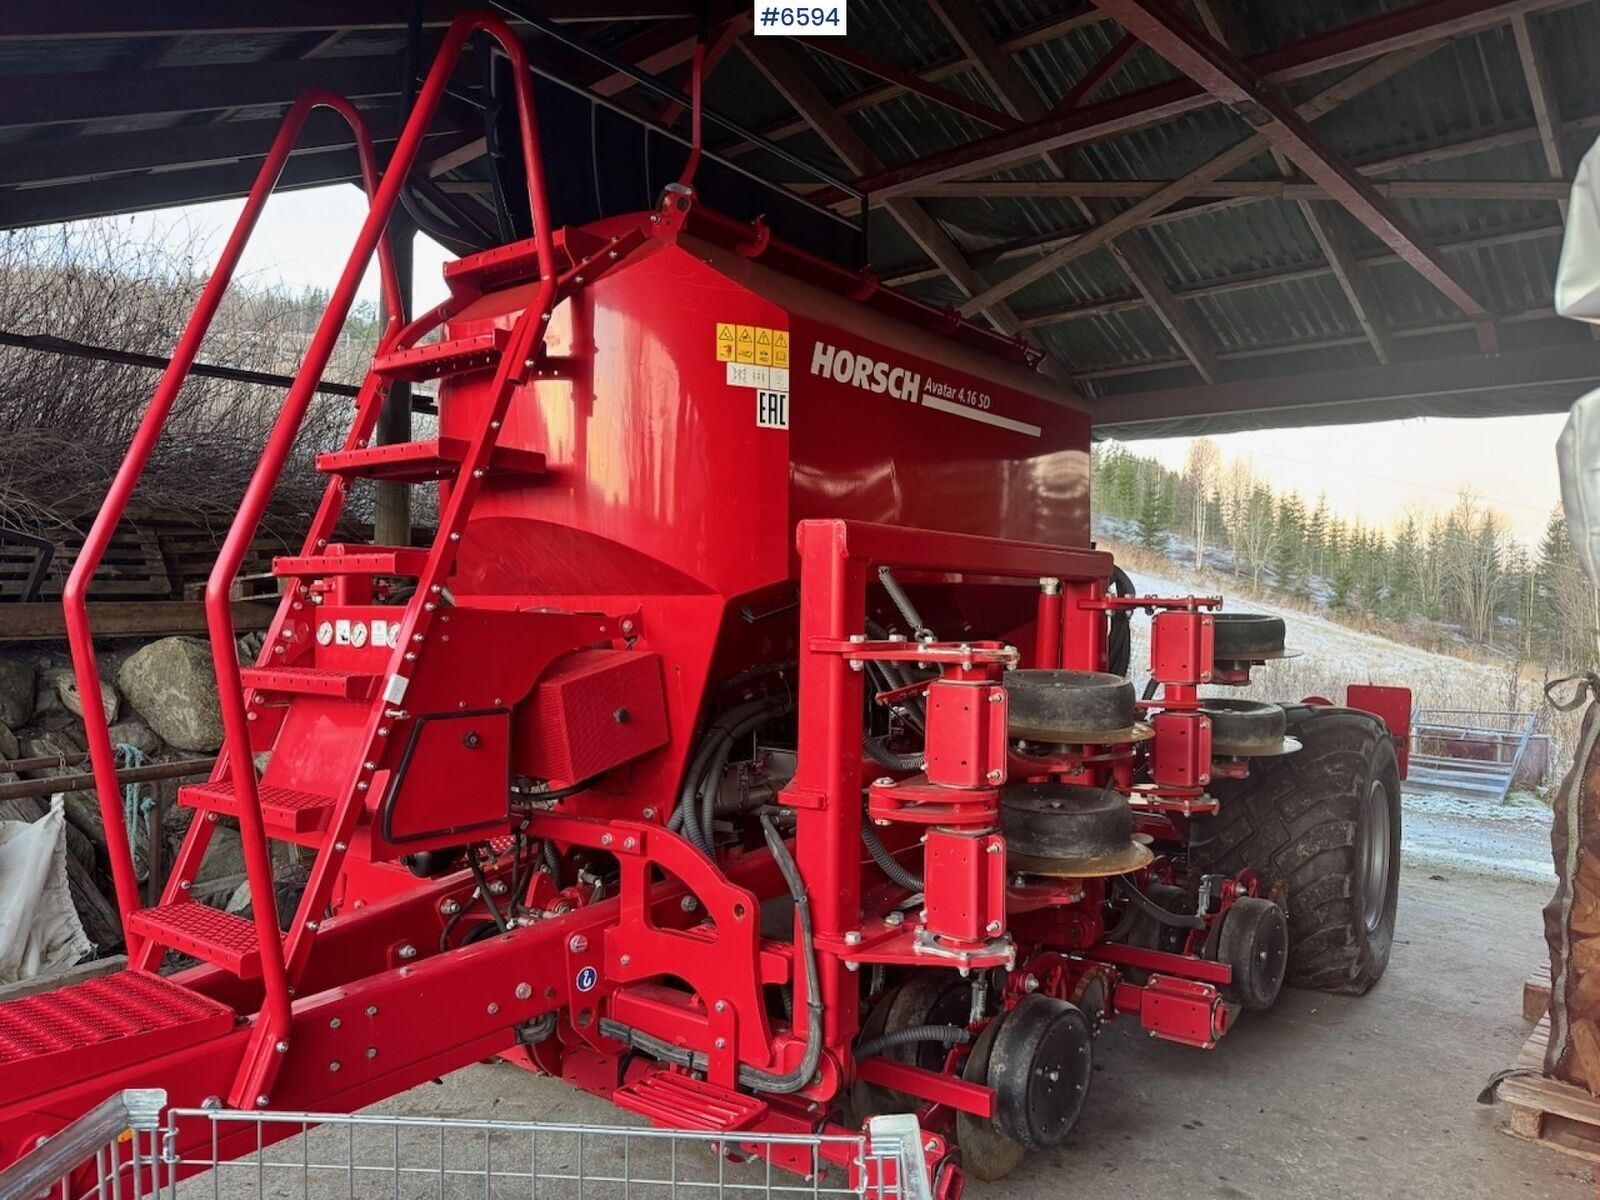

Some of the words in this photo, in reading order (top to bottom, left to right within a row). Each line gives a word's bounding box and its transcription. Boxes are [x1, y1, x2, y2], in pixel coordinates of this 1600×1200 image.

[810, 341, 921, 403] HORSCH
[759, 392, 786, 425] EAC
[924, 377, 957, 400] Avatar
[957, 388, 978, 406] 4.16
[978, 394, 991, 409] SD
